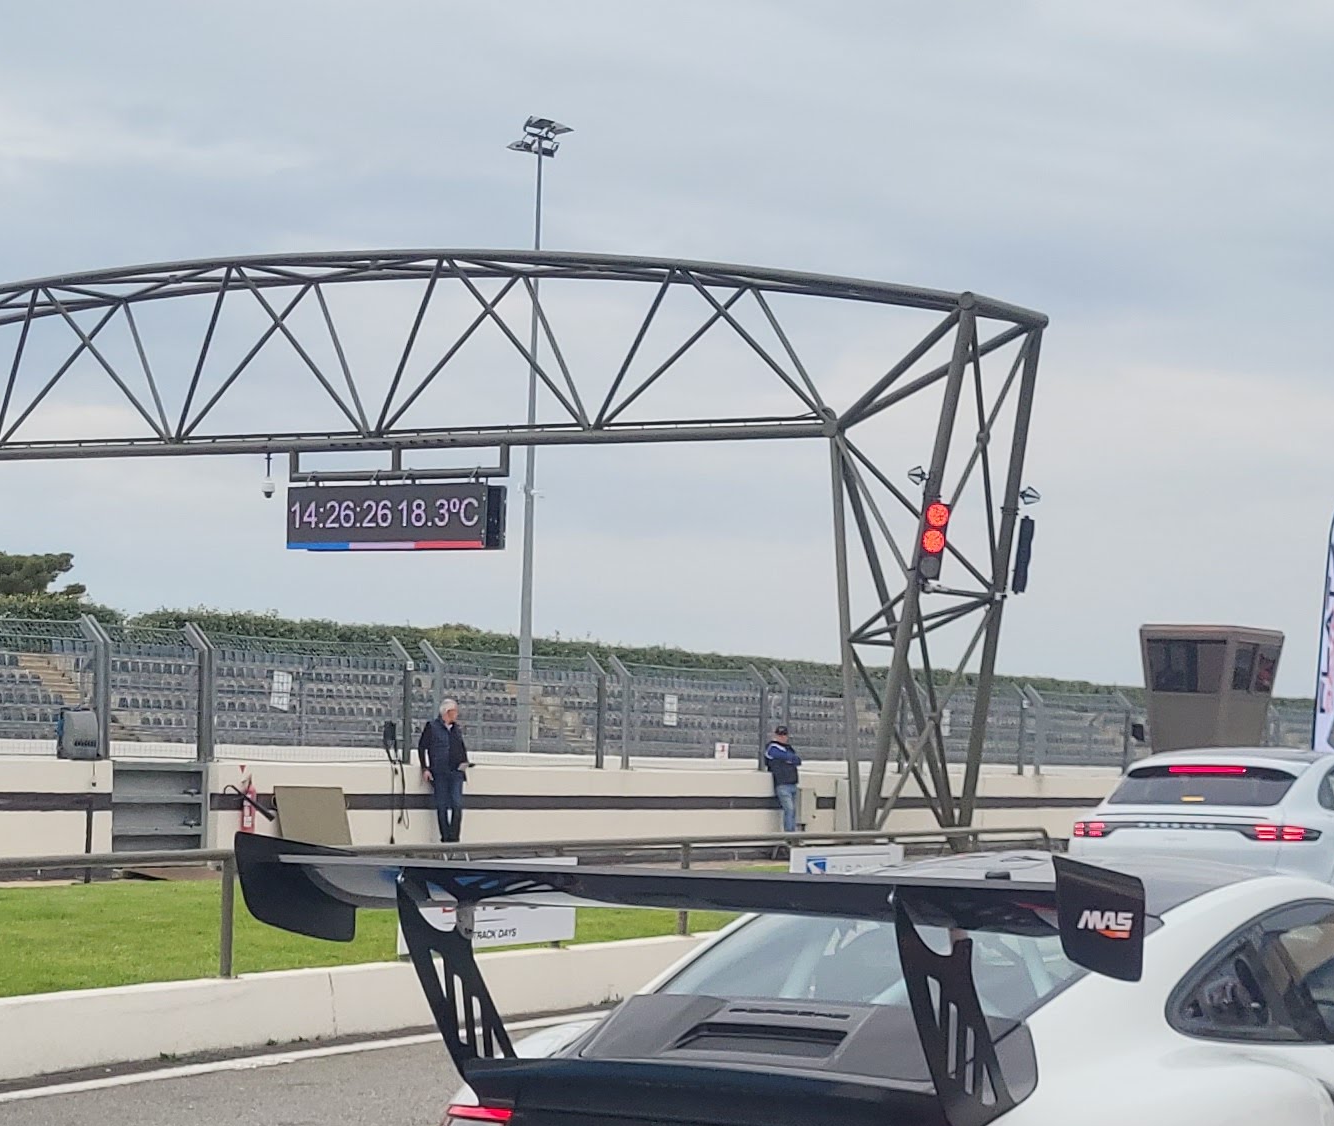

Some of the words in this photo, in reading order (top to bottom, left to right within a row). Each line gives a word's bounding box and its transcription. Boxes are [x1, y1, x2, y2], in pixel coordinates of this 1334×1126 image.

[291, 500, 392, 528] 14:26:26
[1076, 910, 1134, 931] MAS
[499, 928, 517, 938] DAYS
